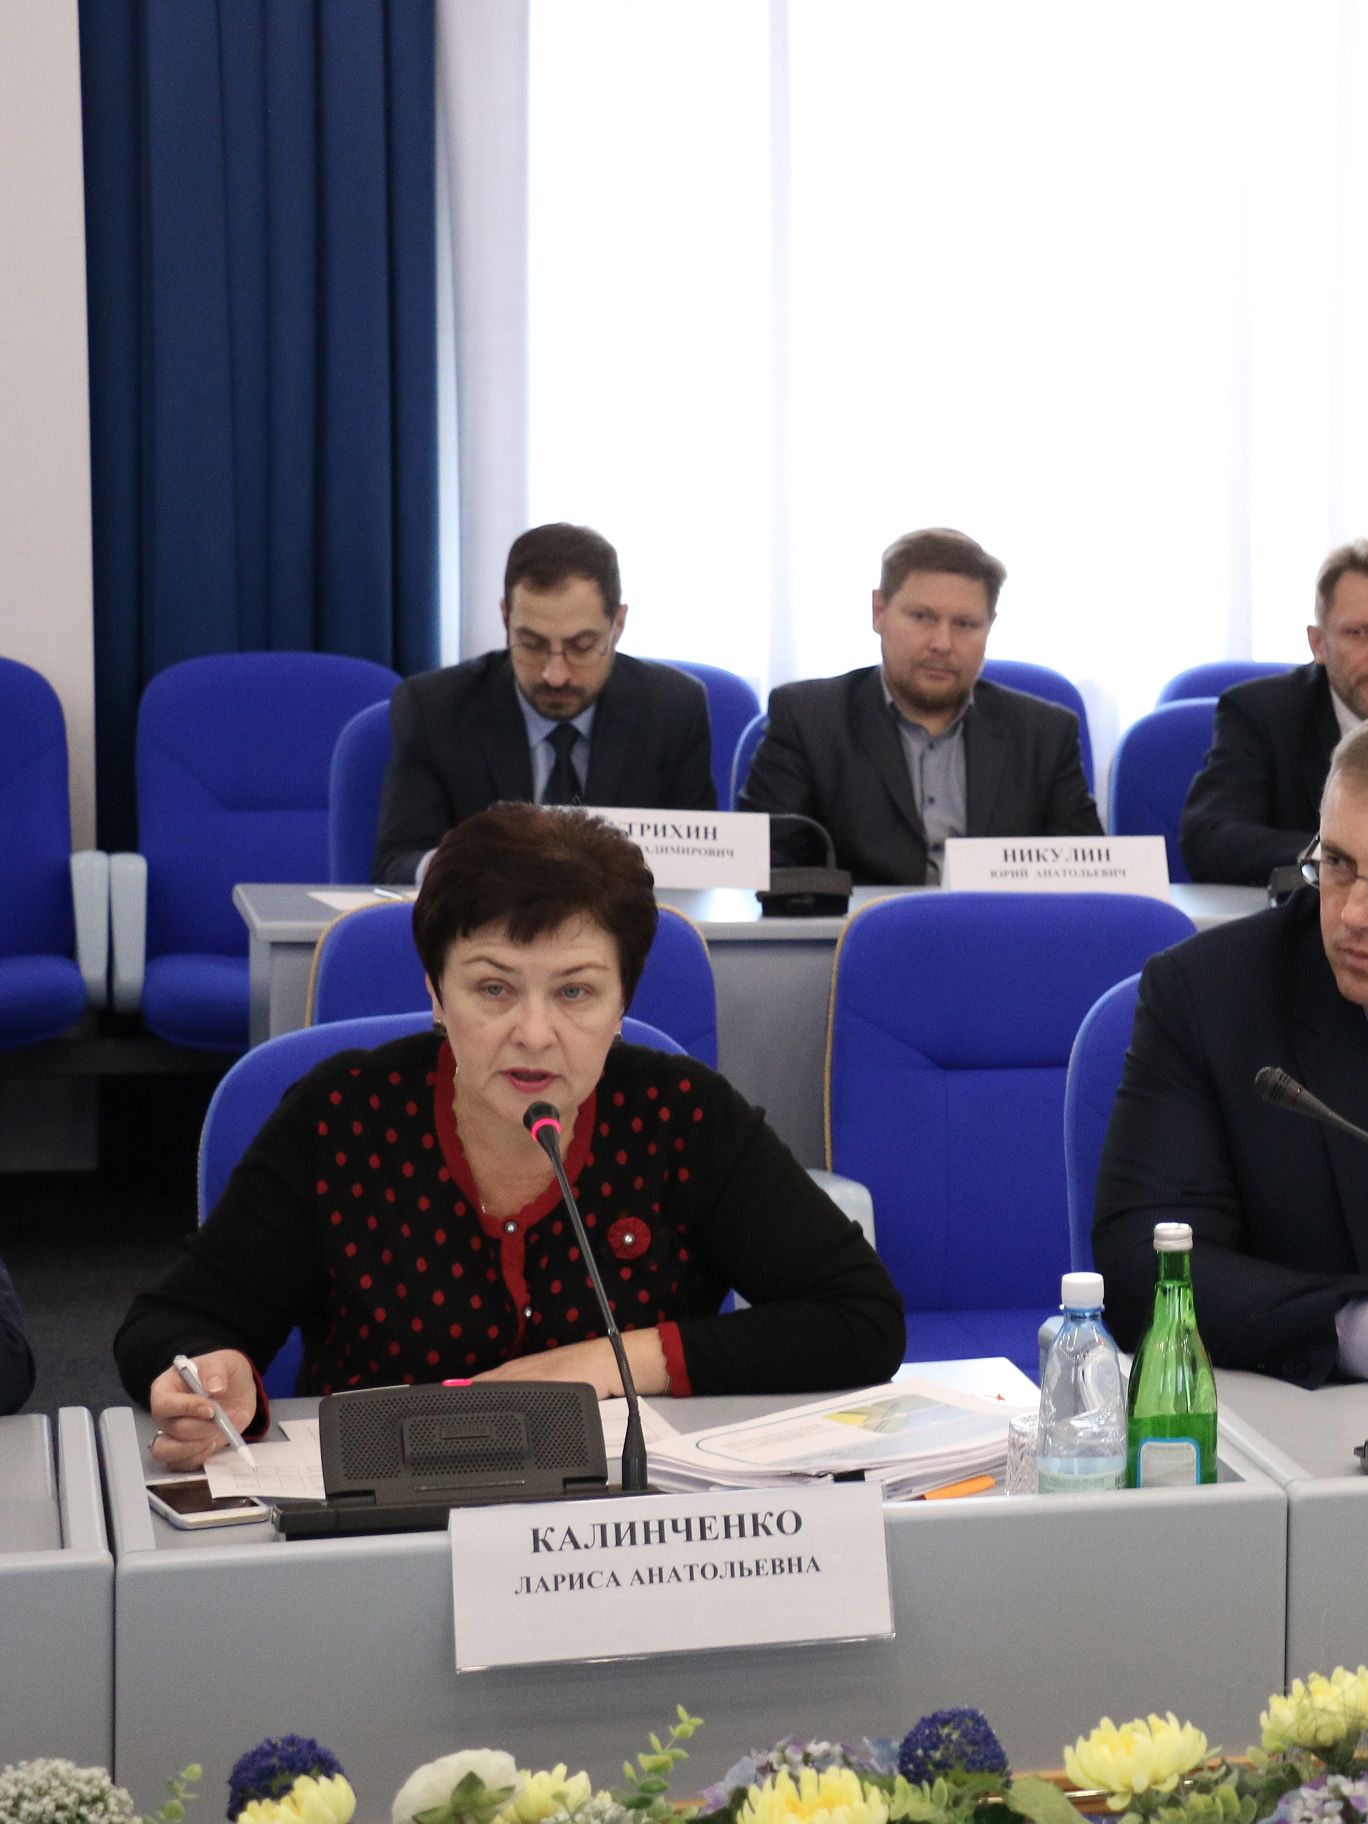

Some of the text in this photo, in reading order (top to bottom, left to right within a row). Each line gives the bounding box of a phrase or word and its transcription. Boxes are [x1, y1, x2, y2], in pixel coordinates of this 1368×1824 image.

[608, 821, 717, 841] ТРИХИН
[641, 845, 735, 858] АДИМИРОВИЧ
[1003, 848, 1111, 862] НИКУЛИН
[990, 866, 1127, 878] ЮРИЙ АНАТОЛЬЕВИЧ
[530, 1509, 803, 1554] КАЛИНЧЕНКО
[514, 1555, 821, 1595] ЛАРИСА АНАТОЛЬЕВНА
